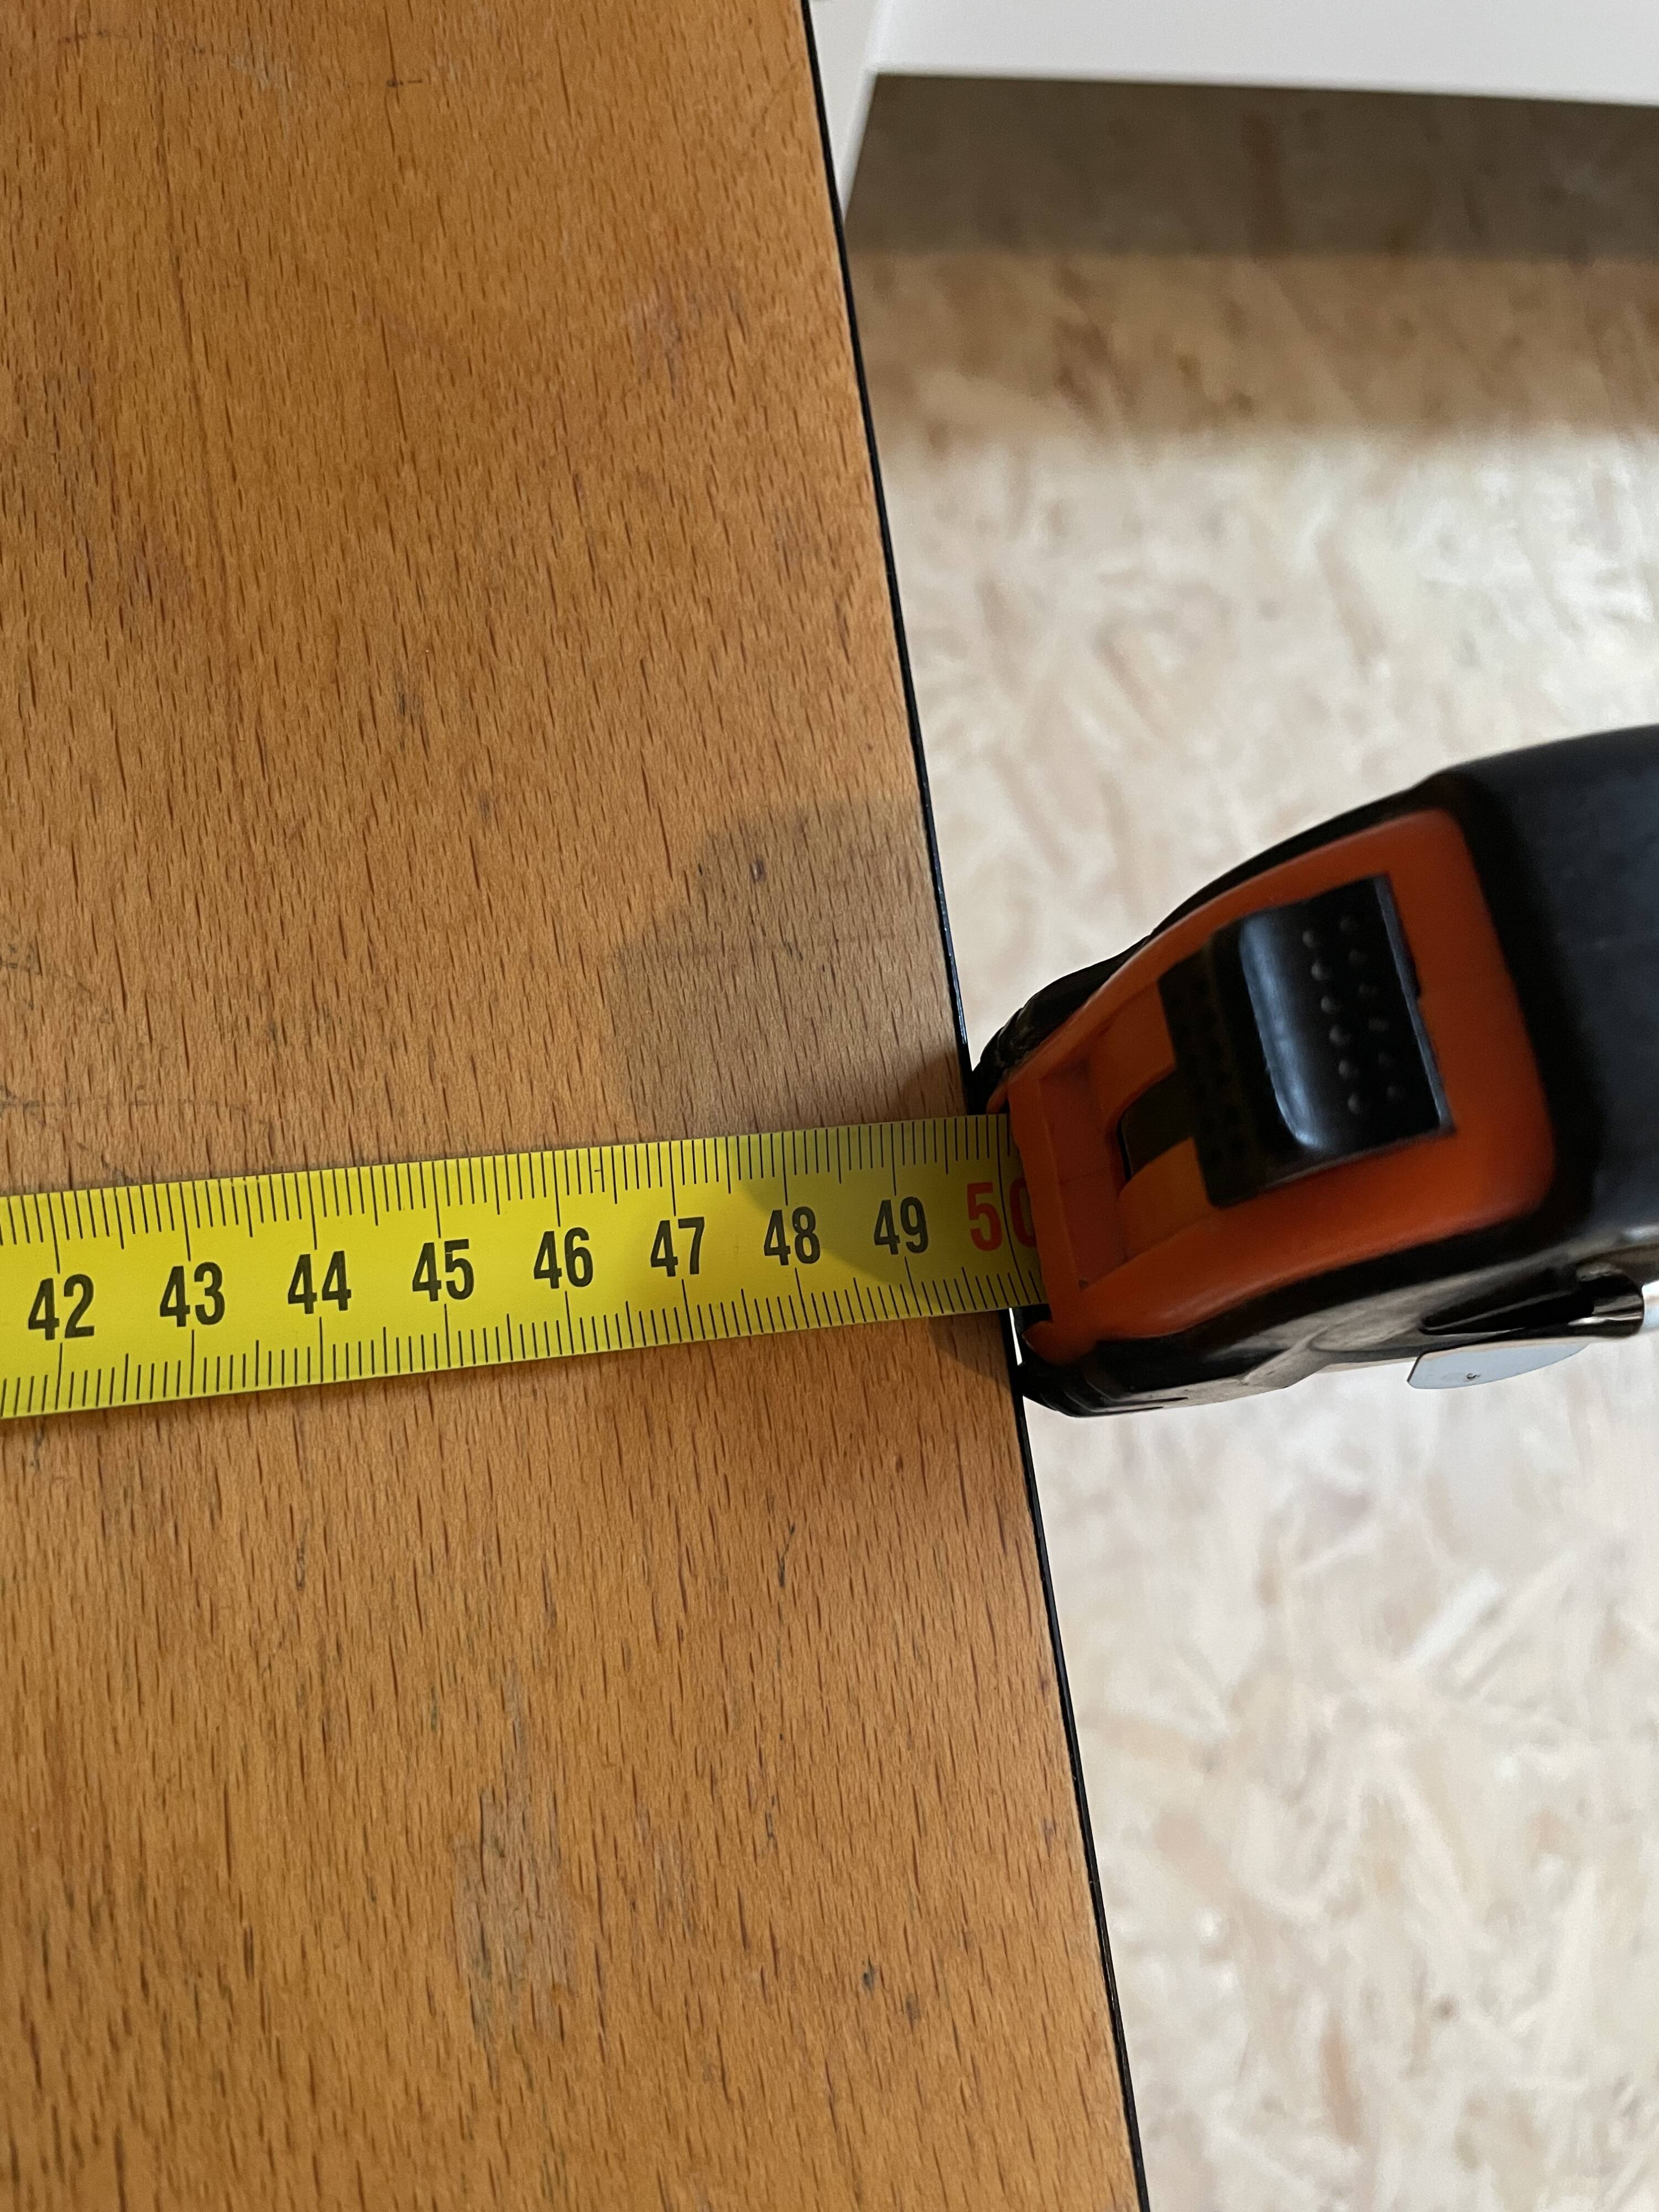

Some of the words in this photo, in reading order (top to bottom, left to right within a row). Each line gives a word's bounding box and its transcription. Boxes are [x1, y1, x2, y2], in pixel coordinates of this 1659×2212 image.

[28, 1274, 95, 1340] 42
[160, 1261, 226, 1327] 43
[288, 1250, 352, 1314] 44
[412, 1238, 474, 1302] 45
[533, 1227, 594, 1289] 46
[650, 1217, 705, 1277] 47
[764, 1206, 821, 1266] 48
[874, 1196, 929, 1255] 49
